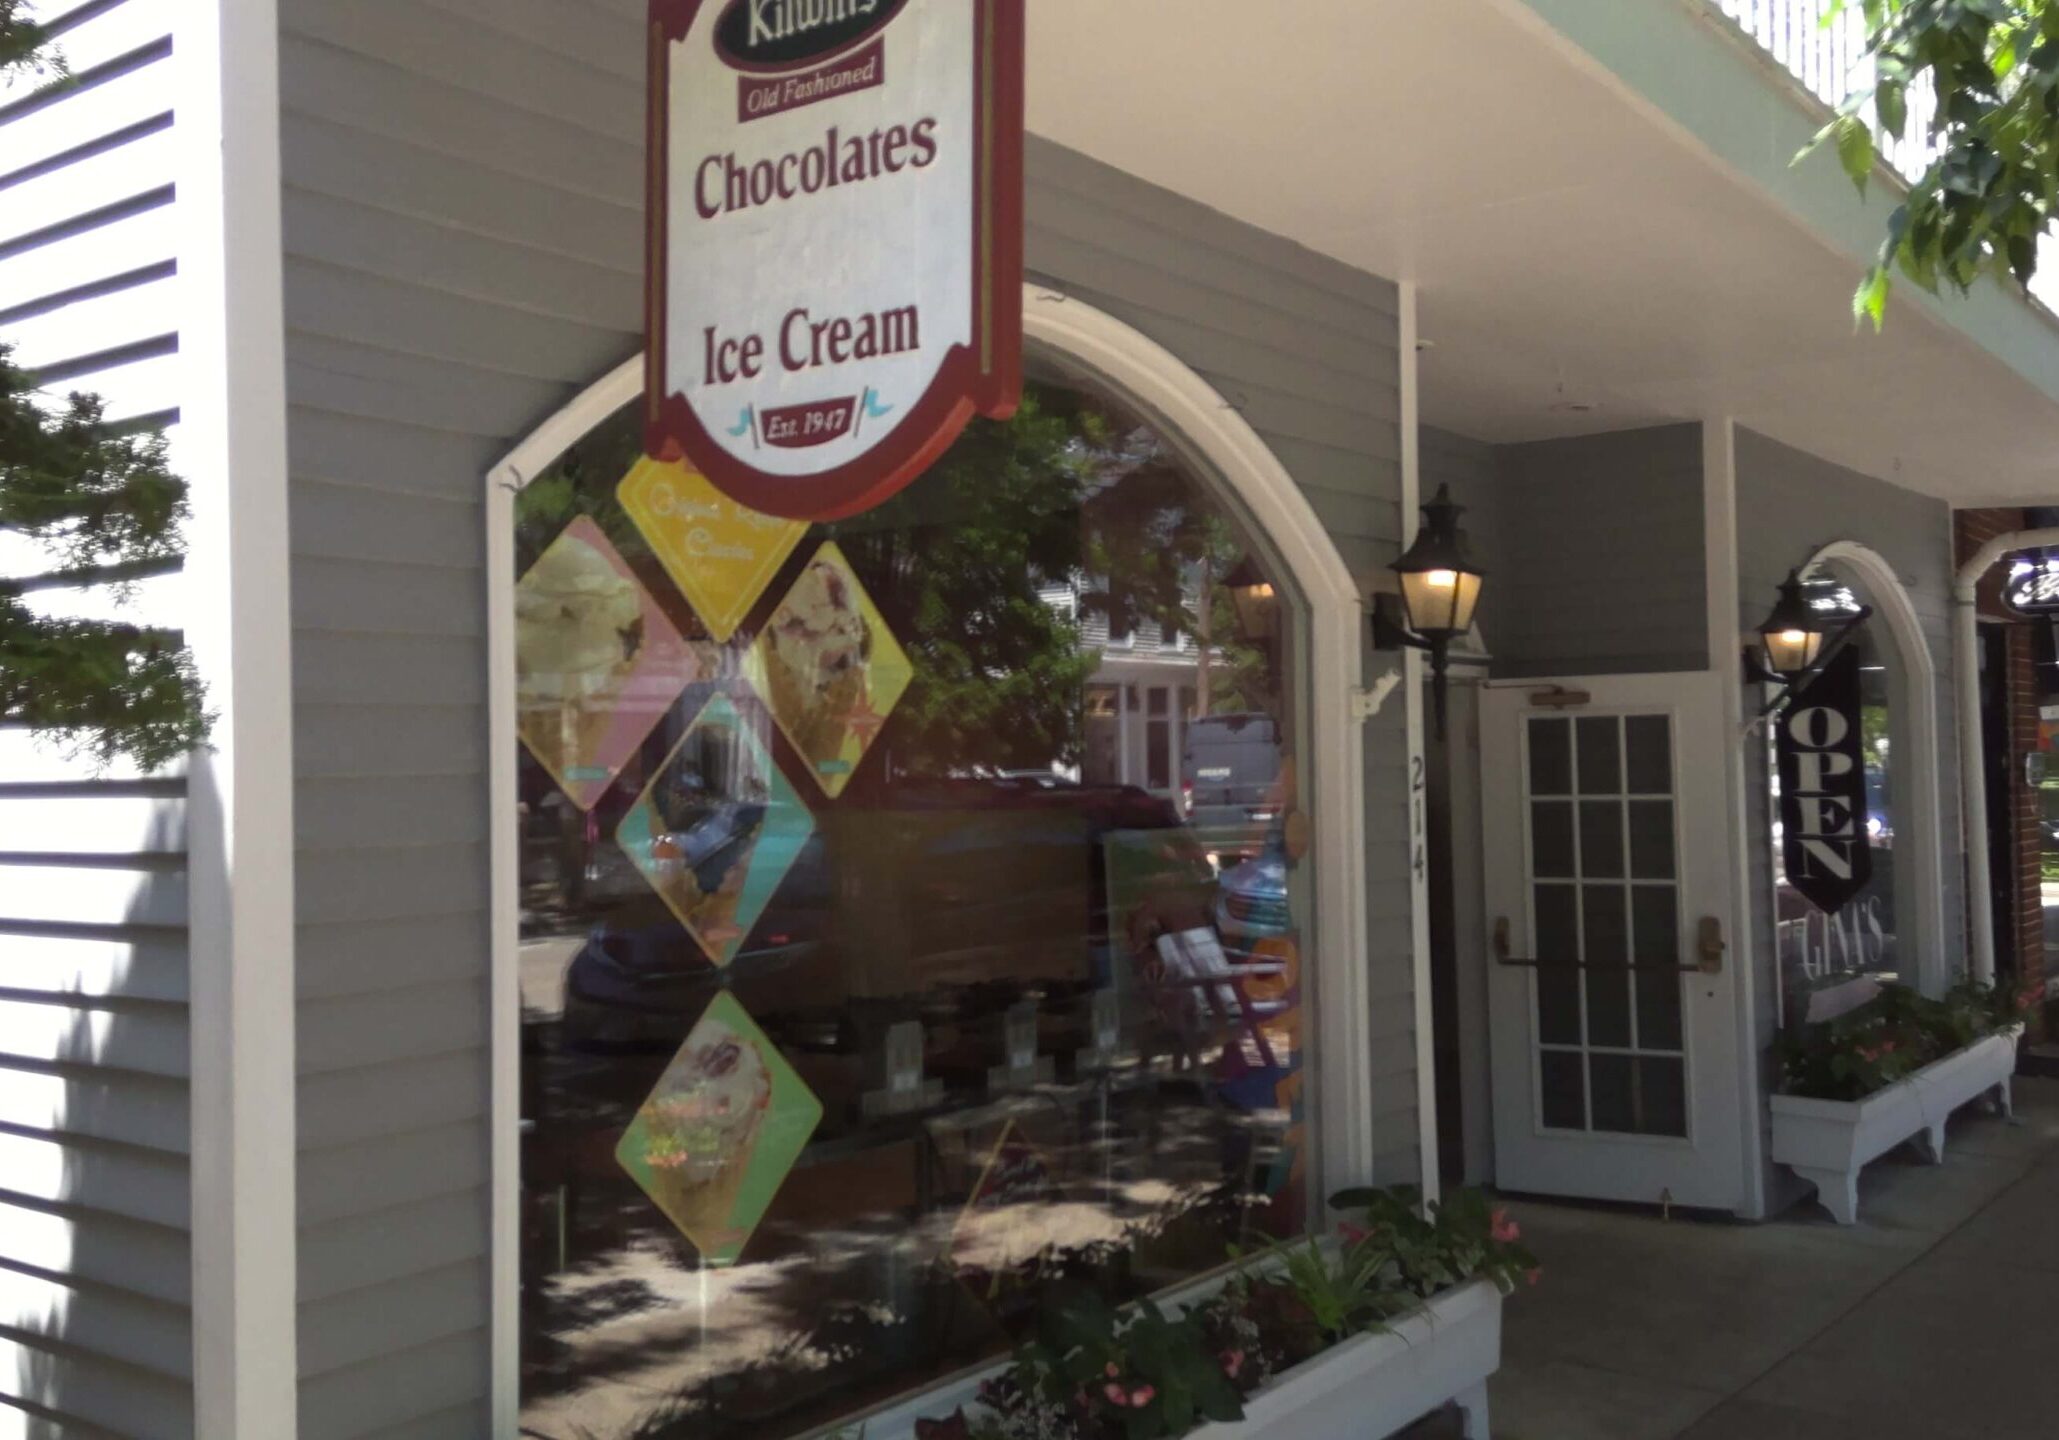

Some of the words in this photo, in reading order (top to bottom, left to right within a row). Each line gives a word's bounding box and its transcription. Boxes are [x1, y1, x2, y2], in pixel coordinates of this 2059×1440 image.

[746, 80, 780, 113] Old
[783, 56, 876, 102] Fashioned
[694, 116, 938, 219] Chocolates
[702, 325, 764, 386] Ice
[778, 304, 920, 372] Cream
[766, 413, 799, 439] Est.
[802, 407, 847, 435] 1947
[1411, 755, 1425, 884] 214
[1788, 706, 1857, 880] OPEN
